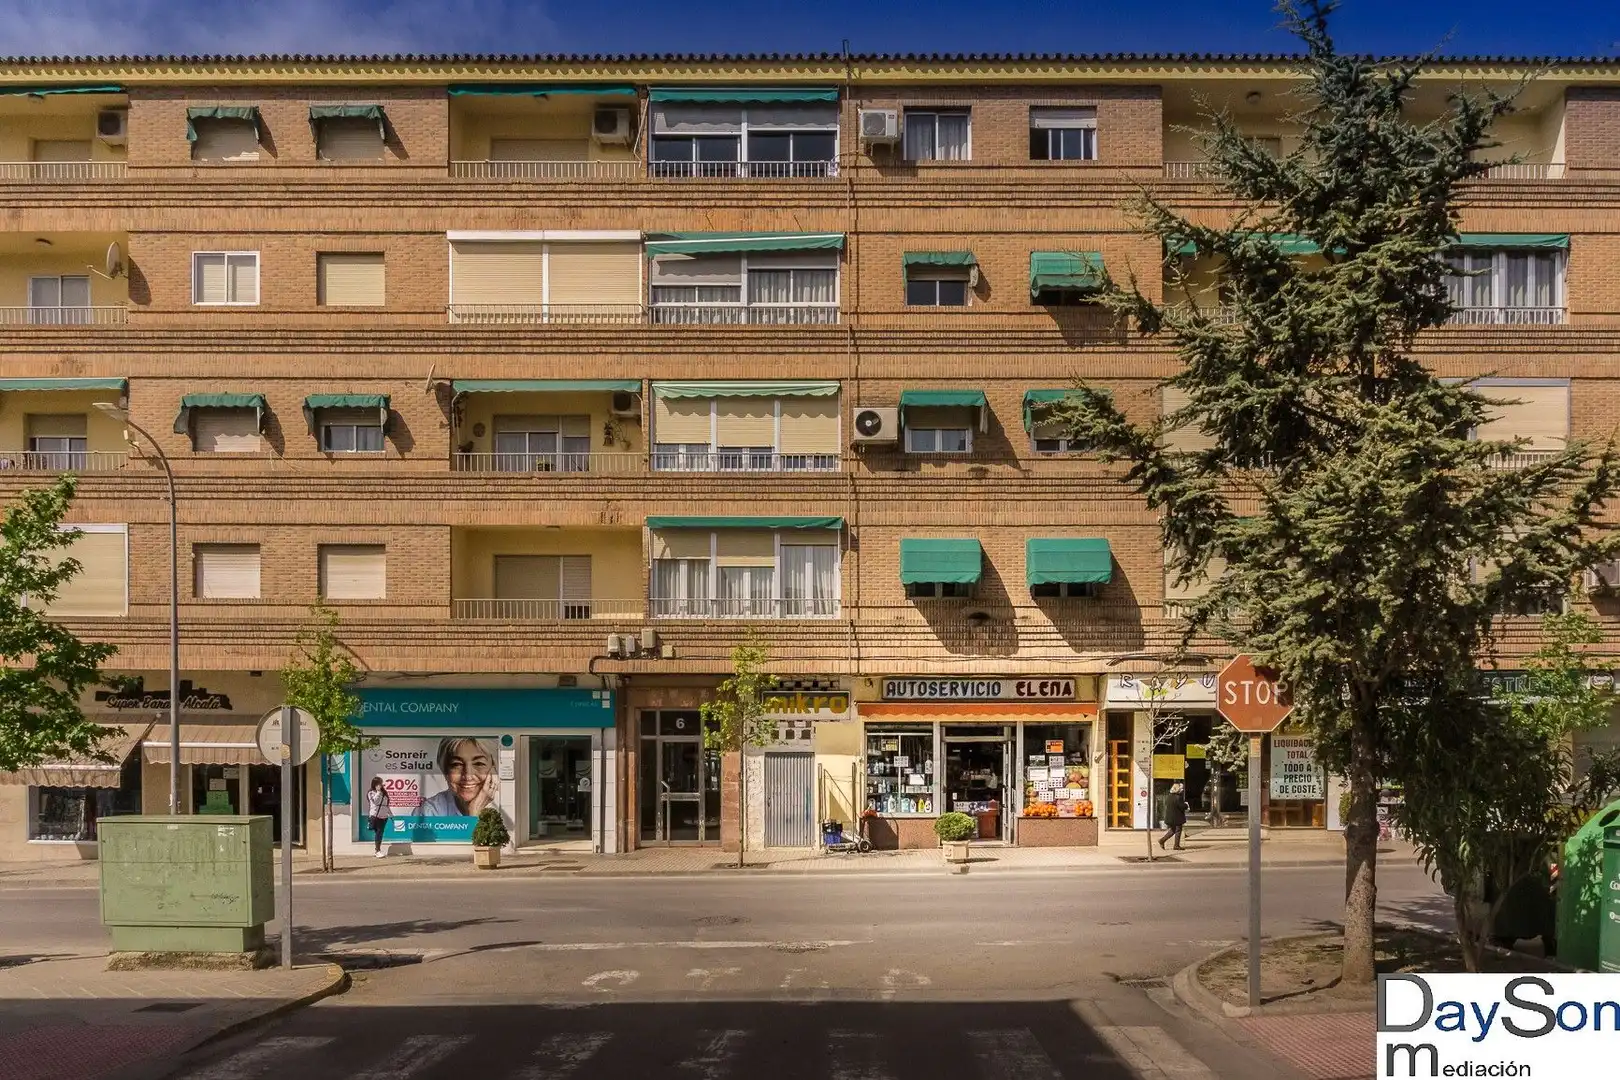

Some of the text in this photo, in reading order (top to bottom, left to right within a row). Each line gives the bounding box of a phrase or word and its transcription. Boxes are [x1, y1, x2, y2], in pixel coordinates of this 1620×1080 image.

[886, 681, 1072, 698] AUTOSERVICIO ELENA
[1224, 681, 1289, 705] STOP
[105, 695, 140, 711] Super
[400, 702, 459, 713] COMPANY
[675, 718, 685, 729] 6
[385, 750, 428, 759] Sonreír
[1287, 750, 1308, 759] TOTAL
[385, 761, 433, 770] es Salud
[1284, 763, 1312, 772] TODO A
[1283, 774, 1312, 783] PRECIO
[1280, 785, 1317, 794] DE COSTE
[434, 822, 469, 830] COMPANY
